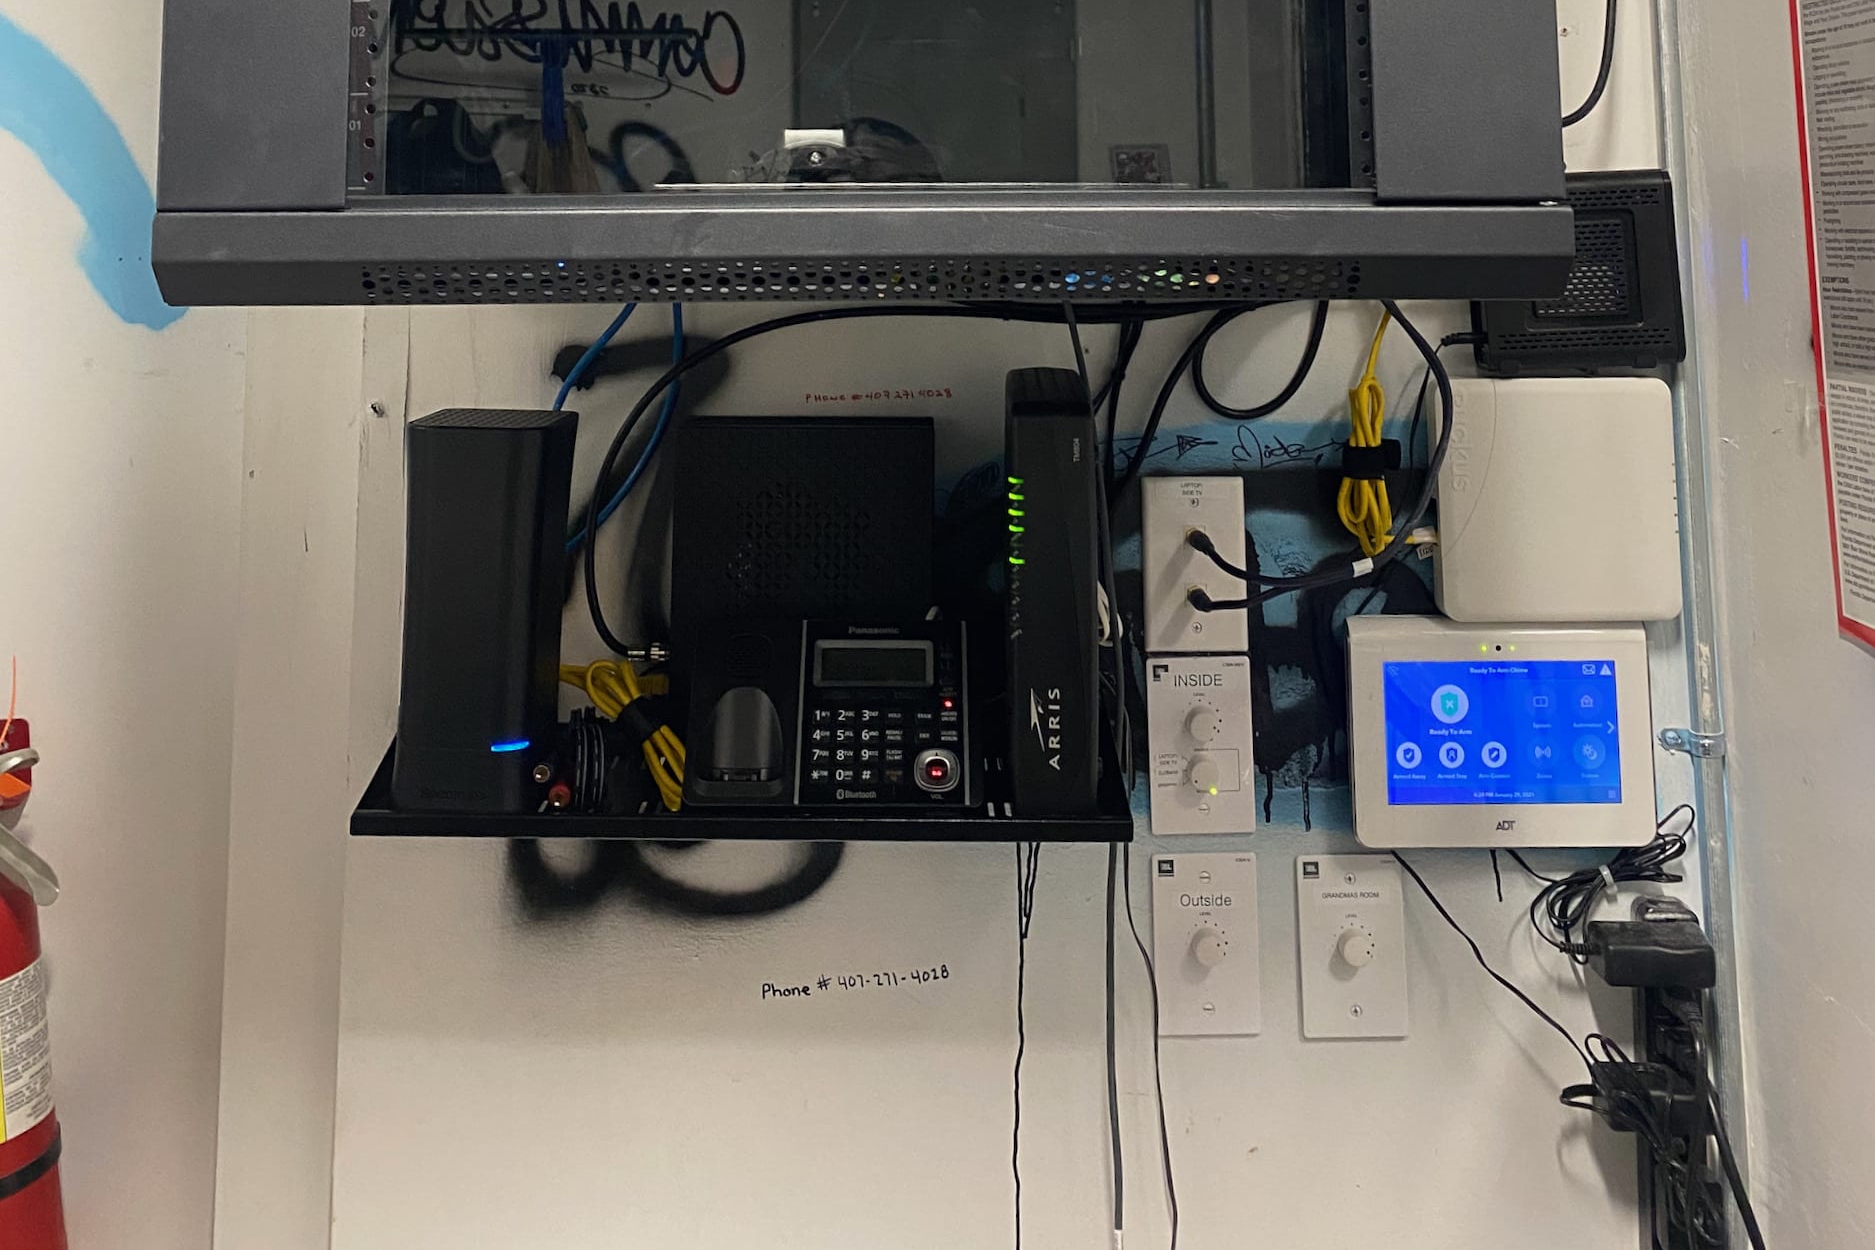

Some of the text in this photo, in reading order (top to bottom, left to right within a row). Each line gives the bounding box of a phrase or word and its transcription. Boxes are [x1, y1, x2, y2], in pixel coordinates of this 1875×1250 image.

[351, 26, 366, 37] 02
[349, 120, 362, 130] 01
[894, 390, 914, 399] 271
[918, 388, 952, 398] 4028
[848, 626, 899, 635] Panasonic
[1174, 674, 1223, 687] INSIDE
[1048, 687, 1061, 770] ARRIS
[845, 790, 877, 799] Bluetooth
[1496, 821, 1515, 831] ADT
[1180, 894, 1232, 906] Outside
[762, 964, 950, 999] Phone # 407-271-4028
